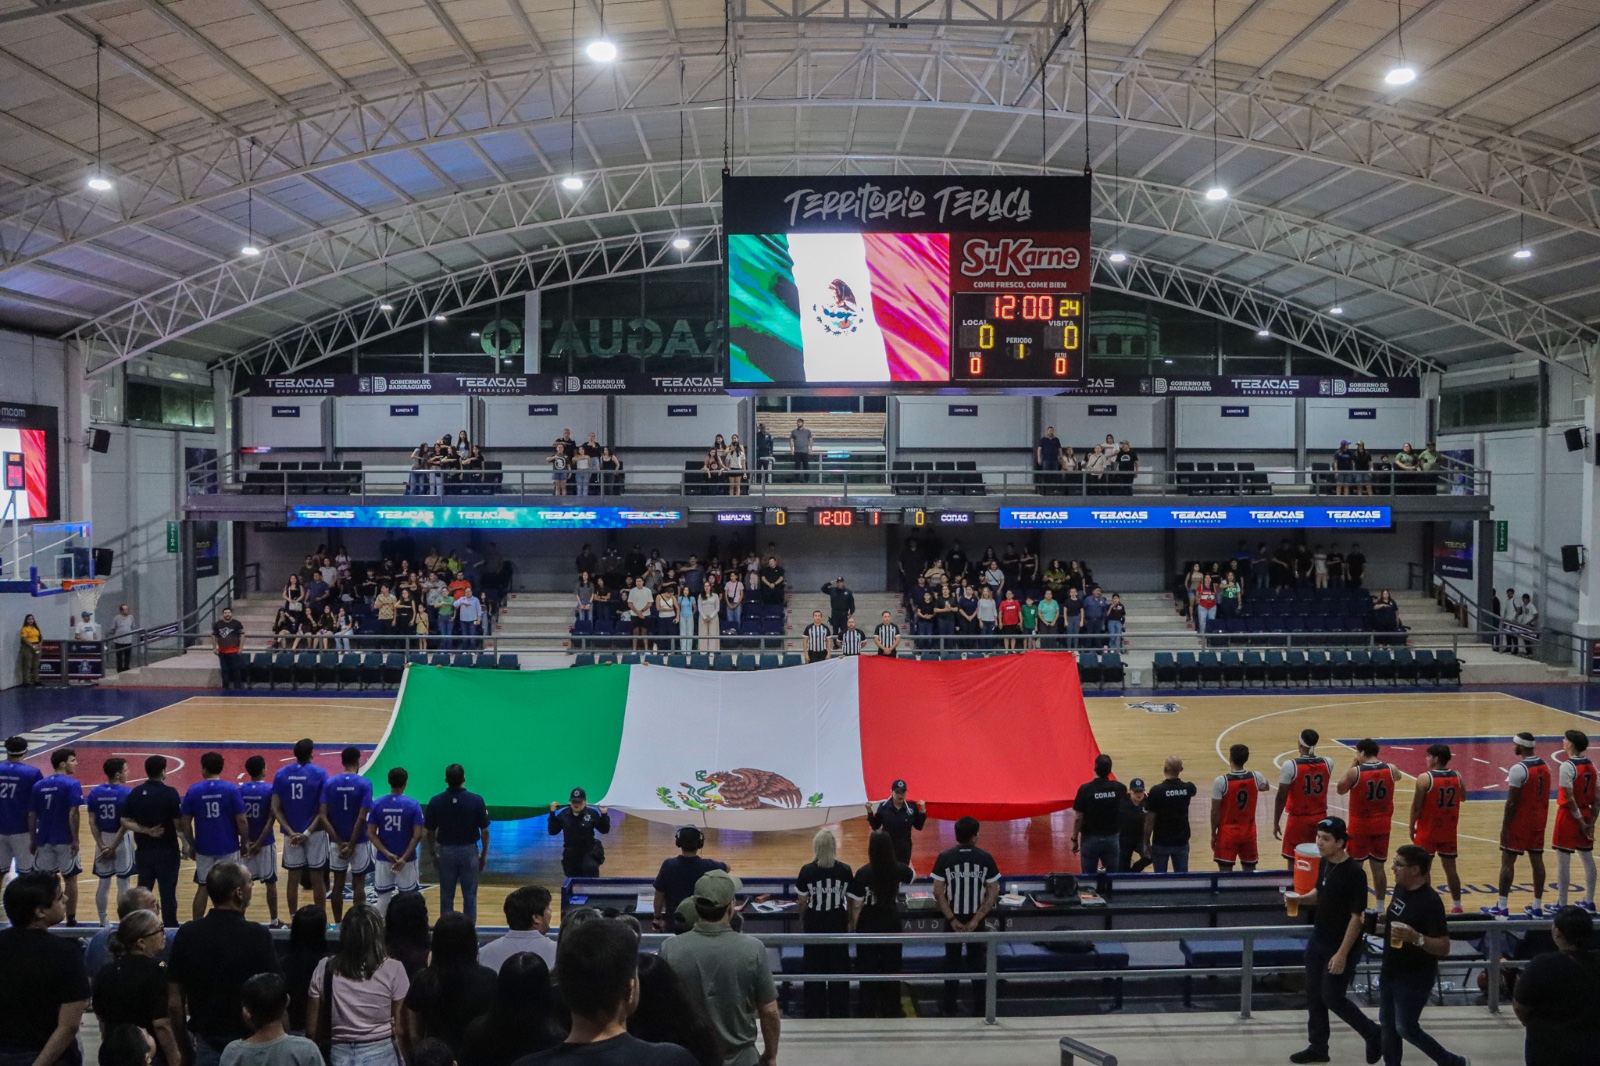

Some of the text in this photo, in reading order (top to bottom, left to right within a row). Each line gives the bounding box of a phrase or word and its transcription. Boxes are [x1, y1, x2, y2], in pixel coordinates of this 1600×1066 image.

[933, 186, 1032, 223] TEBACA
[961, 239, 1080, 276] SuKarne
[995, 295, 1079, 319] 12:00 24
[980, 325, 994, 349] 0
[1064, 326, 1078, 349] 0
[1019, 343, 1024, 359] 1
[970, 357, 981, 374] 0
[1055, 358, 1066, 374] 0
[265, 378, 335, 388] TEBACAS
[456, 377, 527, 387] TEBACAS
[652, 377, 723, 387] TEBACAS
[1231, 379, 1299, 389] TEBACAS
[538, 511, 597, 520] TEBACAS
[776, 511, 785, 525] 0
[819, 511, 852, 525] 12:00
[874, 512, 878, 525] 1
[915, 511, 924, 525] 0
[1011, 511, 1068, 520] TEBACAS
[1091, 511, 1148, 519] TEBACAS
[1171, 511, 1227, 519] TEBACAS
[1249, 511, 1304, 519] TEBACAS
[1326, 511, 1381, 519] TEBACAS
[0, 782, 17, 799] 27
[291, 783, 303, 799] 13
[1304, 774, 1324, 795] 13
[1366, 779, 1387, 801] 16
[1094, 791, 1116, 799] CORAS
[1165, 789, 1187, 797] CORAS
[1236, 789, 1248, 811] 9
[1438, 787, 1456, 809] 12
[45, 794, 52, 809] 7
[343, 794, 348, 810] 1
[100, 804, 116, 819] 33
[206, 802, 220, 818] 19
[245, 803, 260, 818] 28
[384, 815, 401, 831] 24
